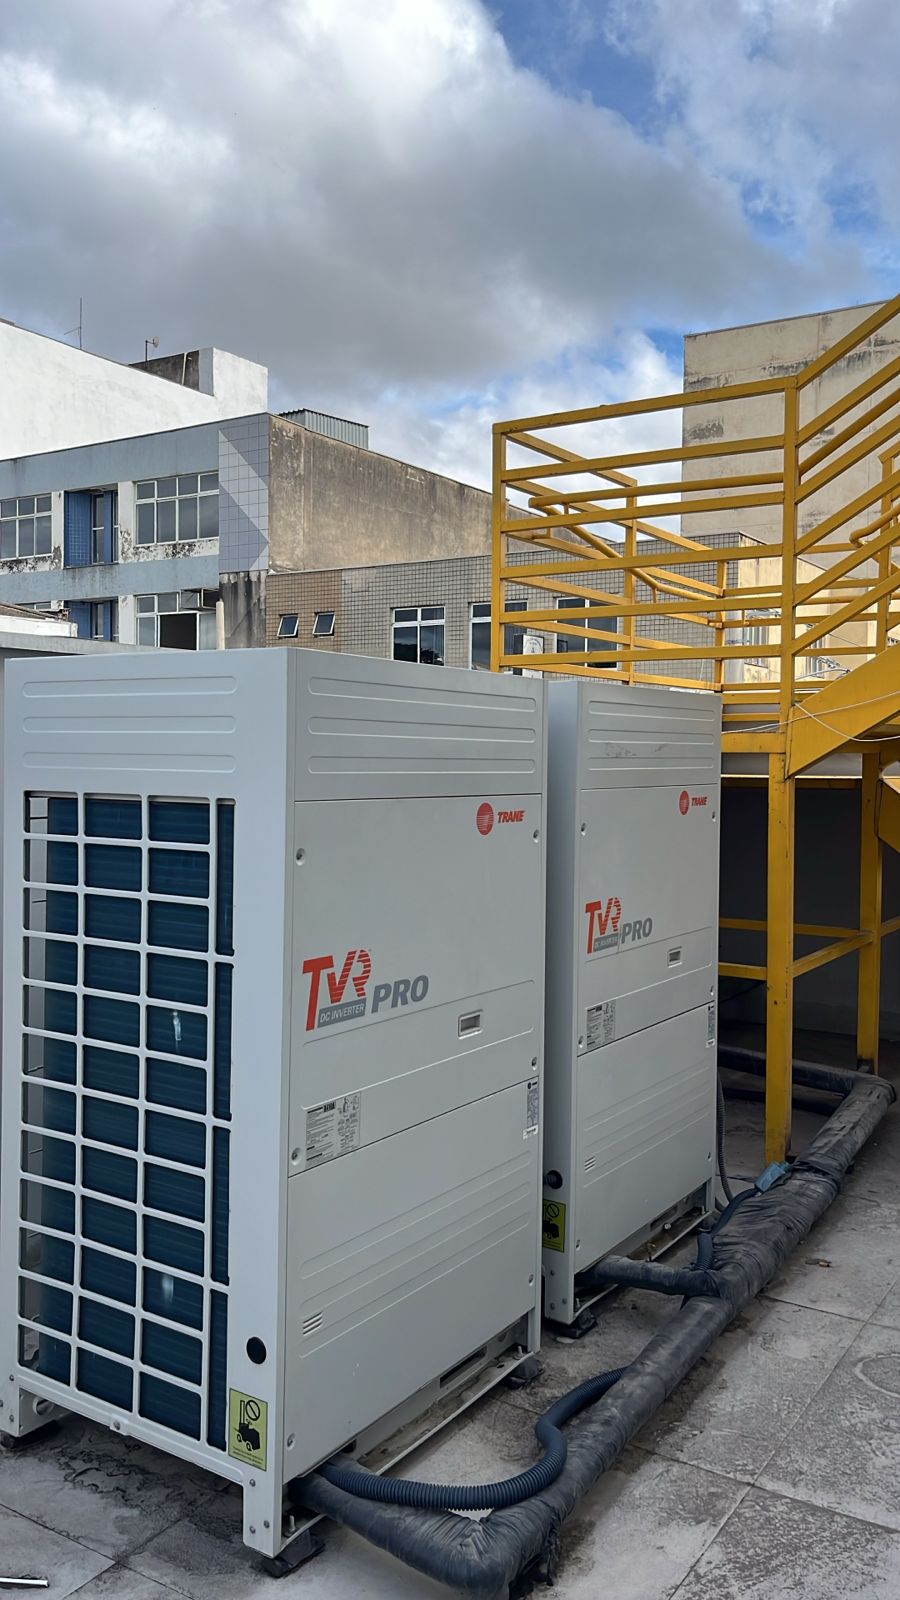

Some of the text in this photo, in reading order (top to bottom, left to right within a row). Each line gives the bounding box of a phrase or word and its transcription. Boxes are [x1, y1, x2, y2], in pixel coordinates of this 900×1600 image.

[498, 810, 525, 823] TRANE
[585, 897, 653, 954] TVR PRO
[302, 949, 429, 1031] TVR PRO
[320, 1003, 365, 1023] DC INVERTER
